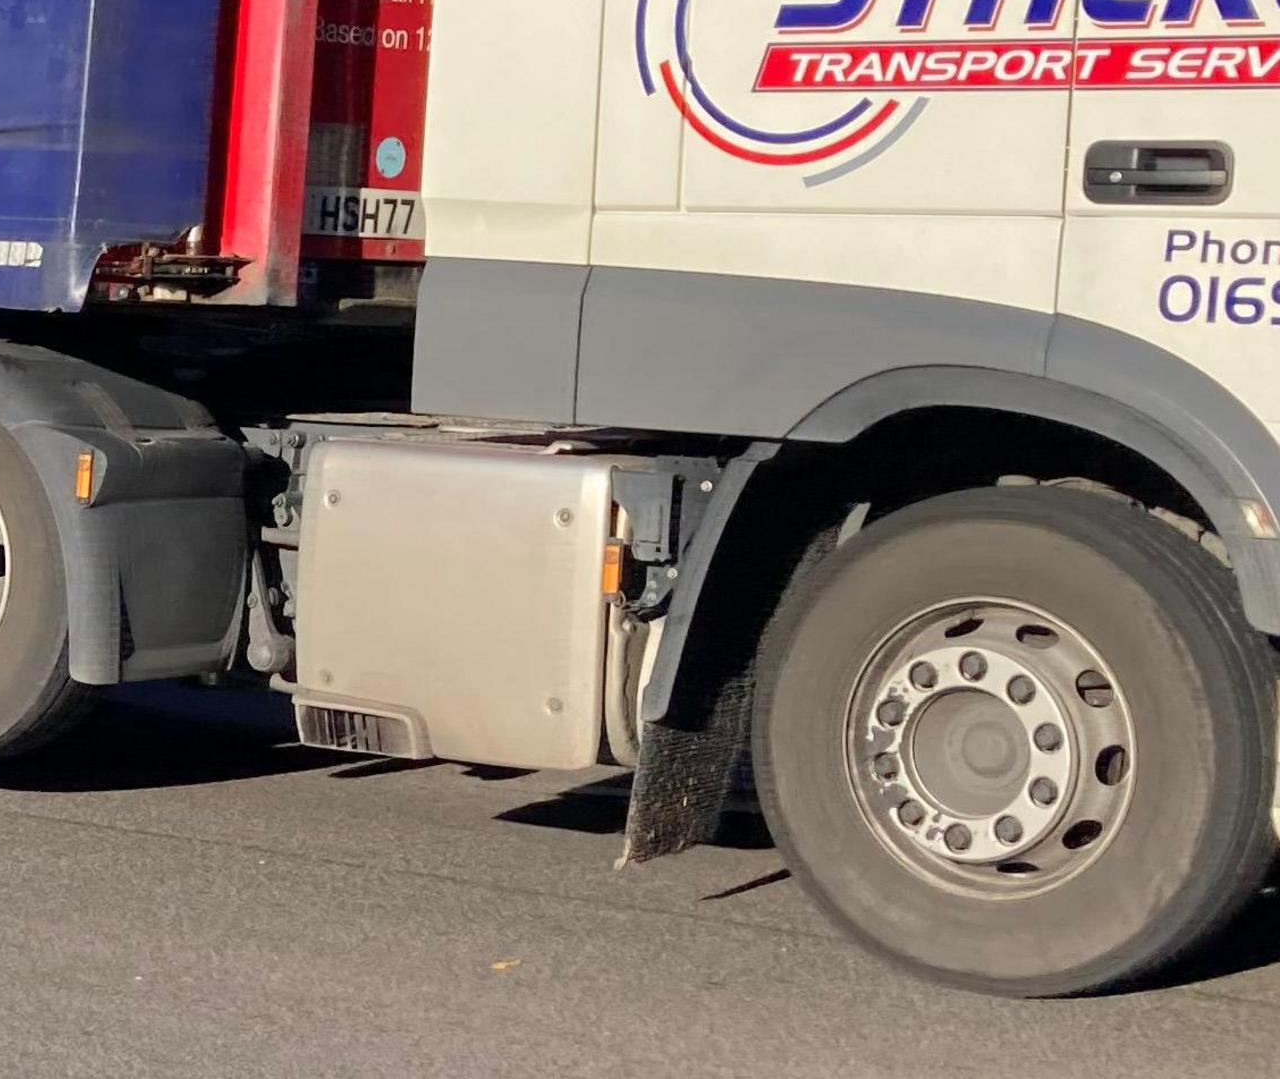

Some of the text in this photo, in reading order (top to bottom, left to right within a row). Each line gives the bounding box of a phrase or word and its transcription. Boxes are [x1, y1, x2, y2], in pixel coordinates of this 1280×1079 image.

[382, 28, 409, 50] on
[789, 47, 1111, 84] TRANSPORT
[1158, 274, 1280, 326] 016
